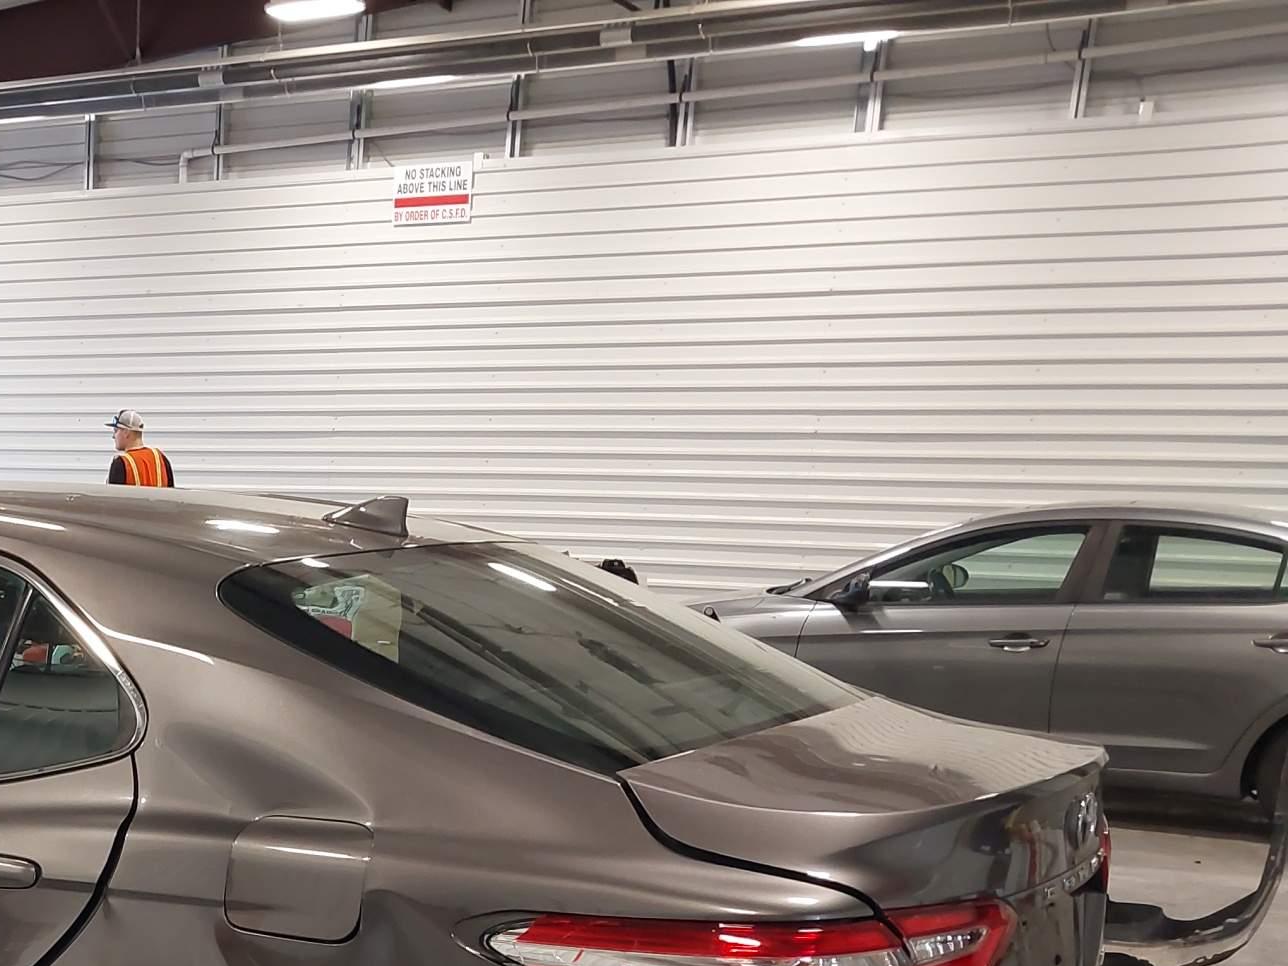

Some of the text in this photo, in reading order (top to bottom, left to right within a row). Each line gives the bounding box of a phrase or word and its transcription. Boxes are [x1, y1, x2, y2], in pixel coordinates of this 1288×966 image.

[405, 166, 461, 180] NO STACKING
[397, 179, 468, 194] ABOVE THIS LINE
[394, 211, 403, 222] BY
[405, 210, 429, 222] ORDER
[431, 209, 440, 220] OF
